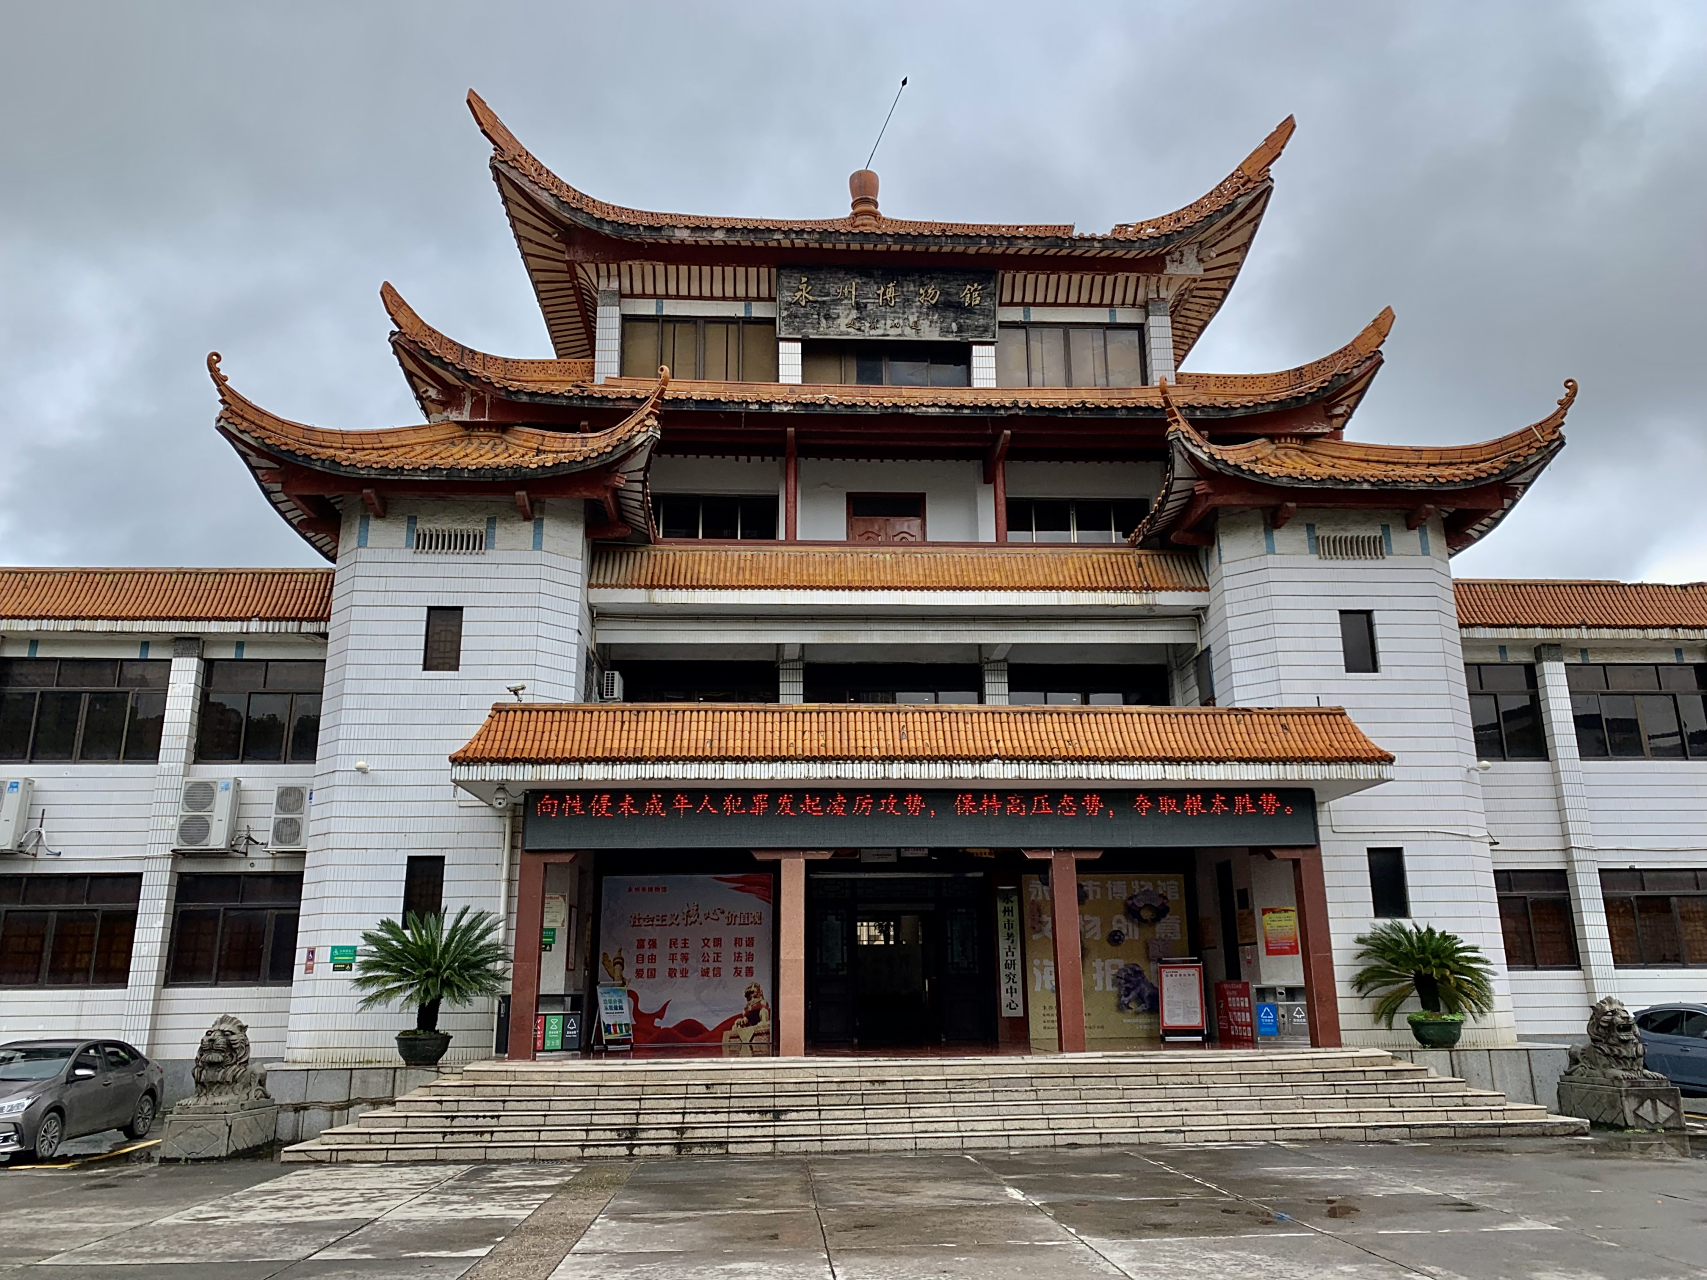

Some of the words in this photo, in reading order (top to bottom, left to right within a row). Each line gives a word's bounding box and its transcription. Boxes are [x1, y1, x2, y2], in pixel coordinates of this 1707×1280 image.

[630, 902, 763, 927] 社会主义核心价值观
[636, 938, 657, 950] 富强
[669, 938, 690, 949] 民主
[701, 937, 722, 948] 文明
[733, 936, 755, 948] 和谐
[635, 953, 657, 964] 自由
[668, 952, 690, 964] 平等
[701, 952, 722, 963] 公正
[733, 951, 754, 963] 法治
[1001, 892, 1019, 1011] 永州市考古研究中心
[635, 968, 657, 979] 爱国
[667, 967, 689, 978] 敬业
[700, 967, 722, 978] 诚信
[733, 966, 754, 978] 友善
